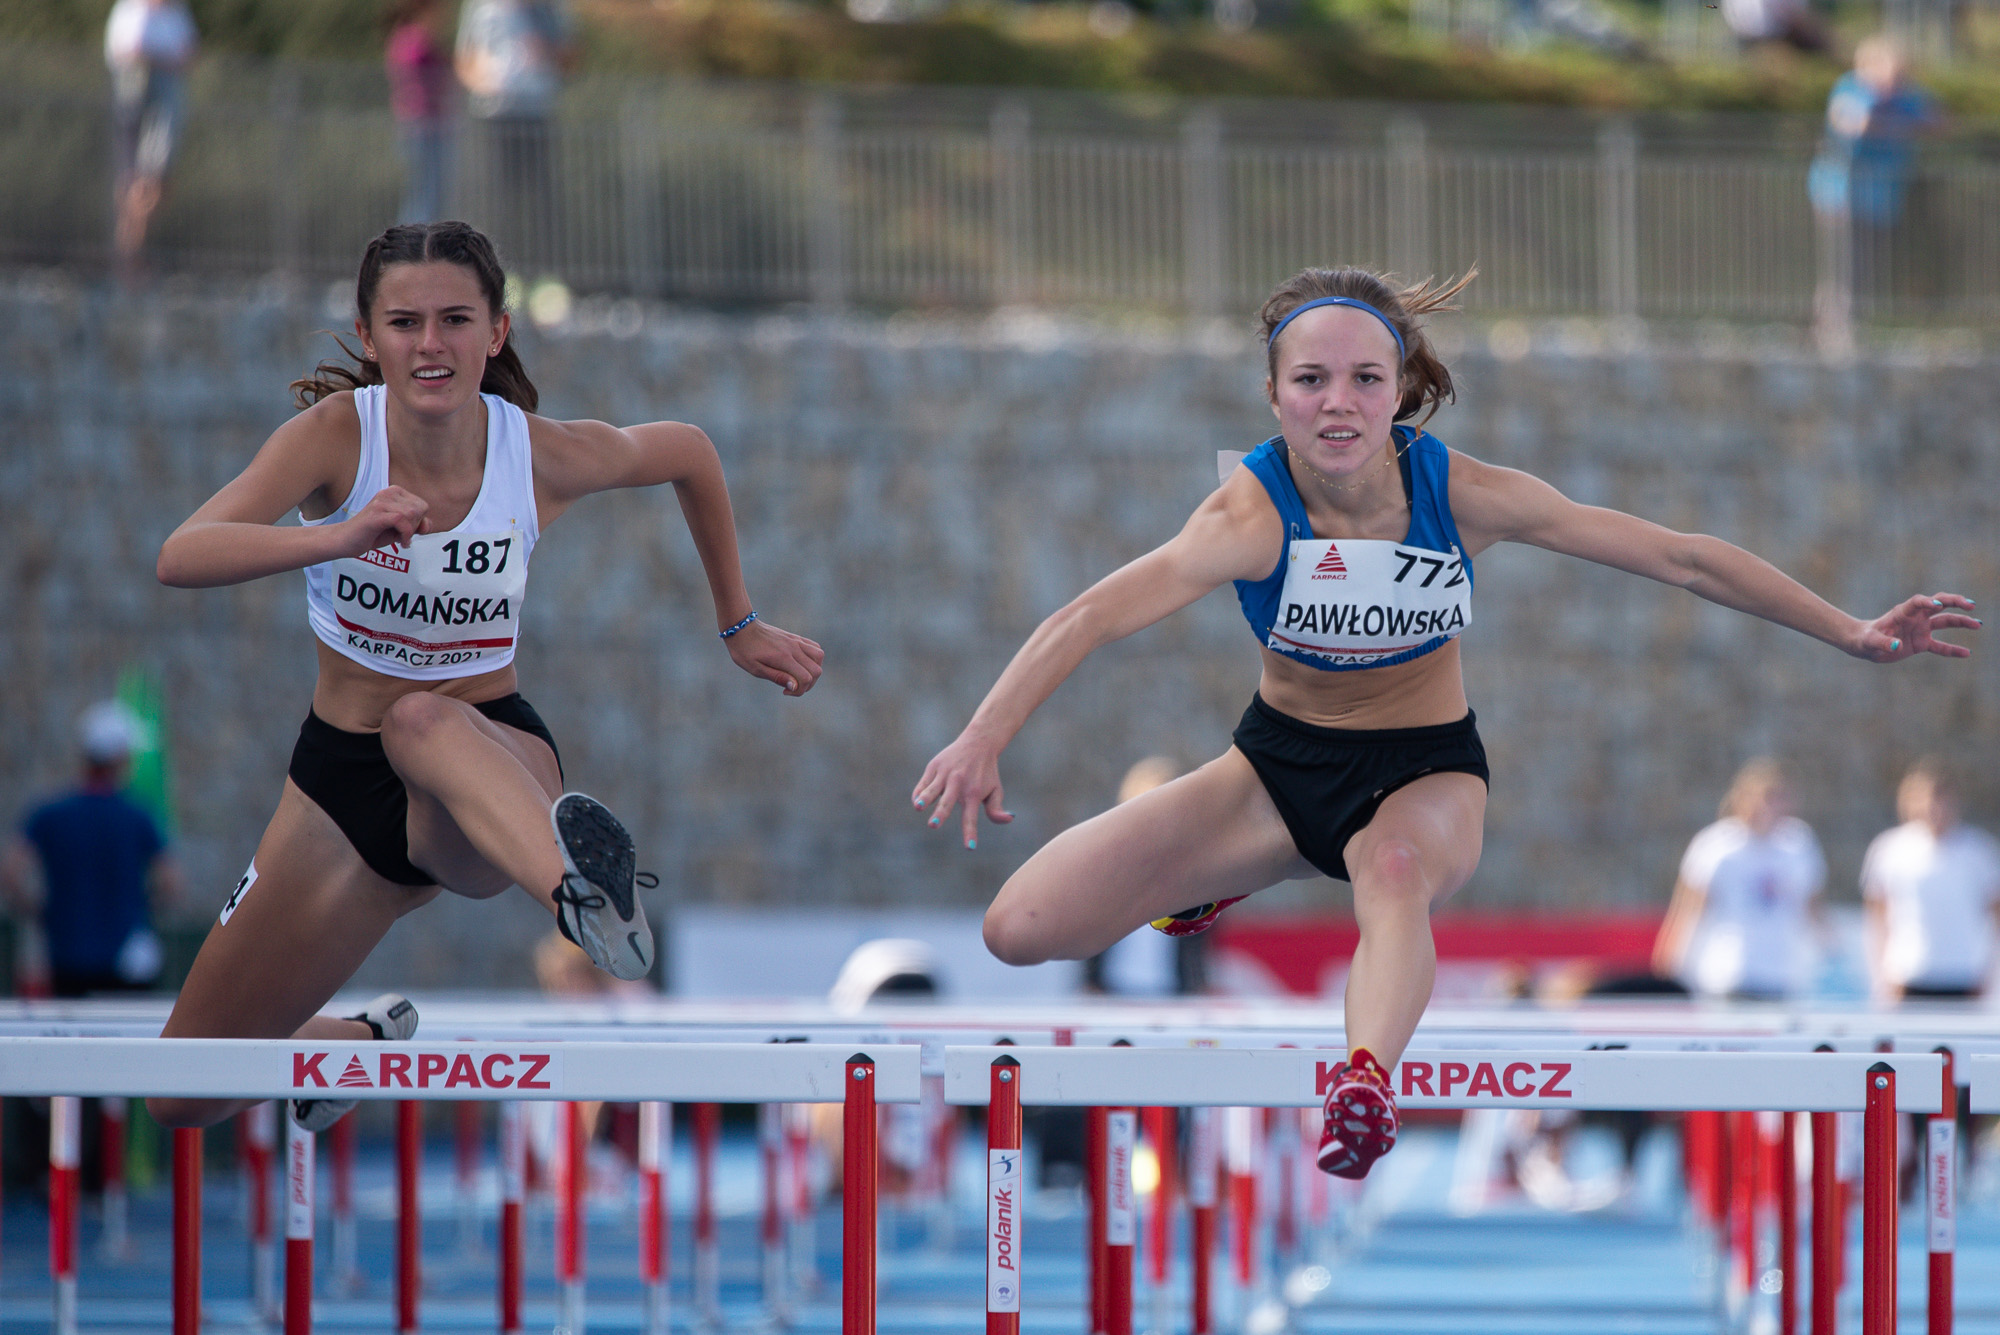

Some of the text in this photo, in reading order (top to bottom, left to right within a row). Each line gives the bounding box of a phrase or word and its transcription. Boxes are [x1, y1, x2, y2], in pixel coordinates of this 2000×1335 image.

[441, 537, 512, 574] 187
[1394, 550, 1465, 589] 772
[337, 573, 510, 625] DOMAŃSKA
[1284, 603, 1465, 637] PAWŁOWSKA
[347, 634, 482, 666] KARPACZ 2021
[293, 1053, 550, 1090] KARPACZ
[1315, 1061, 1572, 1098] KRPACZ
[993, 1187, 1015, 1271] polanik
